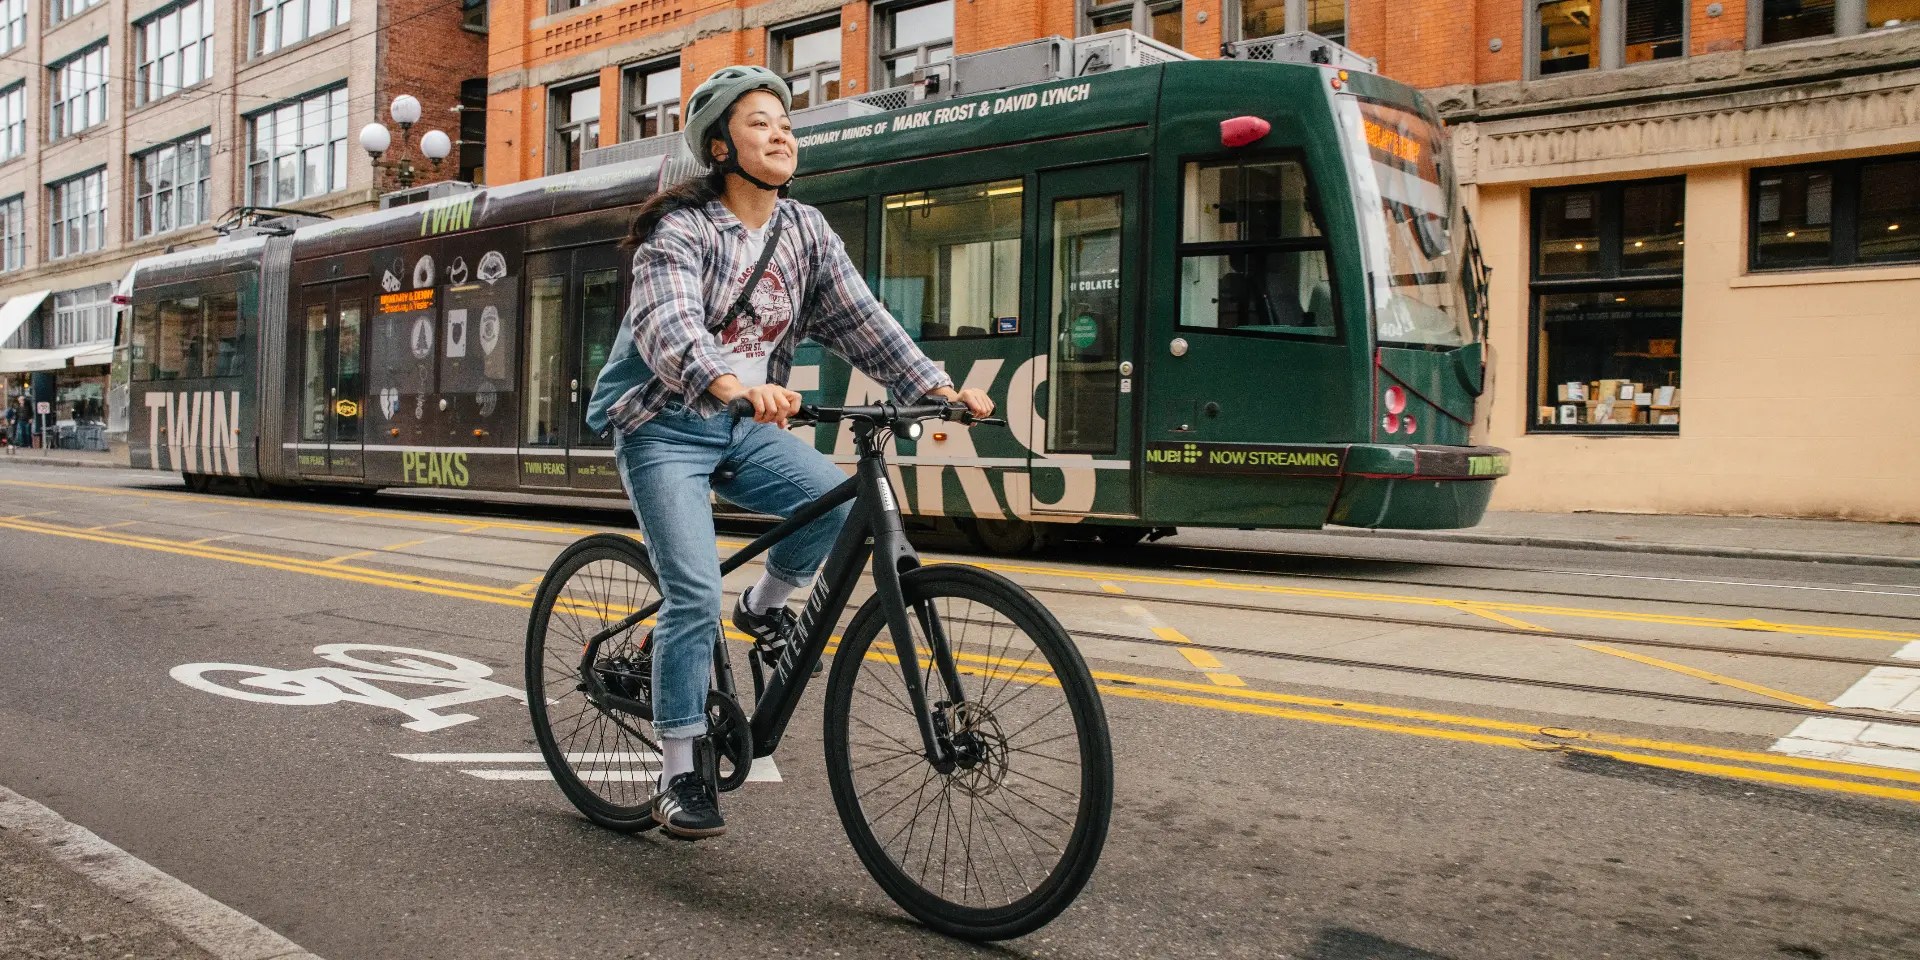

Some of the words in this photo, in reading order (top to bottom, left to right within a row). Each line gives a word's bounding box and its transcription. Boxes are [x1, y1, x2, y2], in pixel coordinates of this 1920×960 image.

[796, 130, 841, 148] VISIONARY
[841, 125, 872, 141] MINDS
[874, 122, 888, 134] OF
[892, 111, 932, 132] MARK
[933, 103, 976, 125] FROST
[978, 101, 990, 117] &
[993, 92, 1037, 115] DAVID
[1040, 83, 1090, 107] LYNCH
[421, 199, 474, 237] TWIN
[145, 388, 240, 477] TWIN
[402, 452, 470, 487] PEAKS
[524, 462, 541, 474] TWIN
[543, 463, 566, 475] PEAKS
[1146, 450, 1181, 463] MUBI
[1209, 451, 1246, 465] NOW
[1248, 451, 1339, 467] STREAMING
[776, 571, 830, 685] AVENTON
